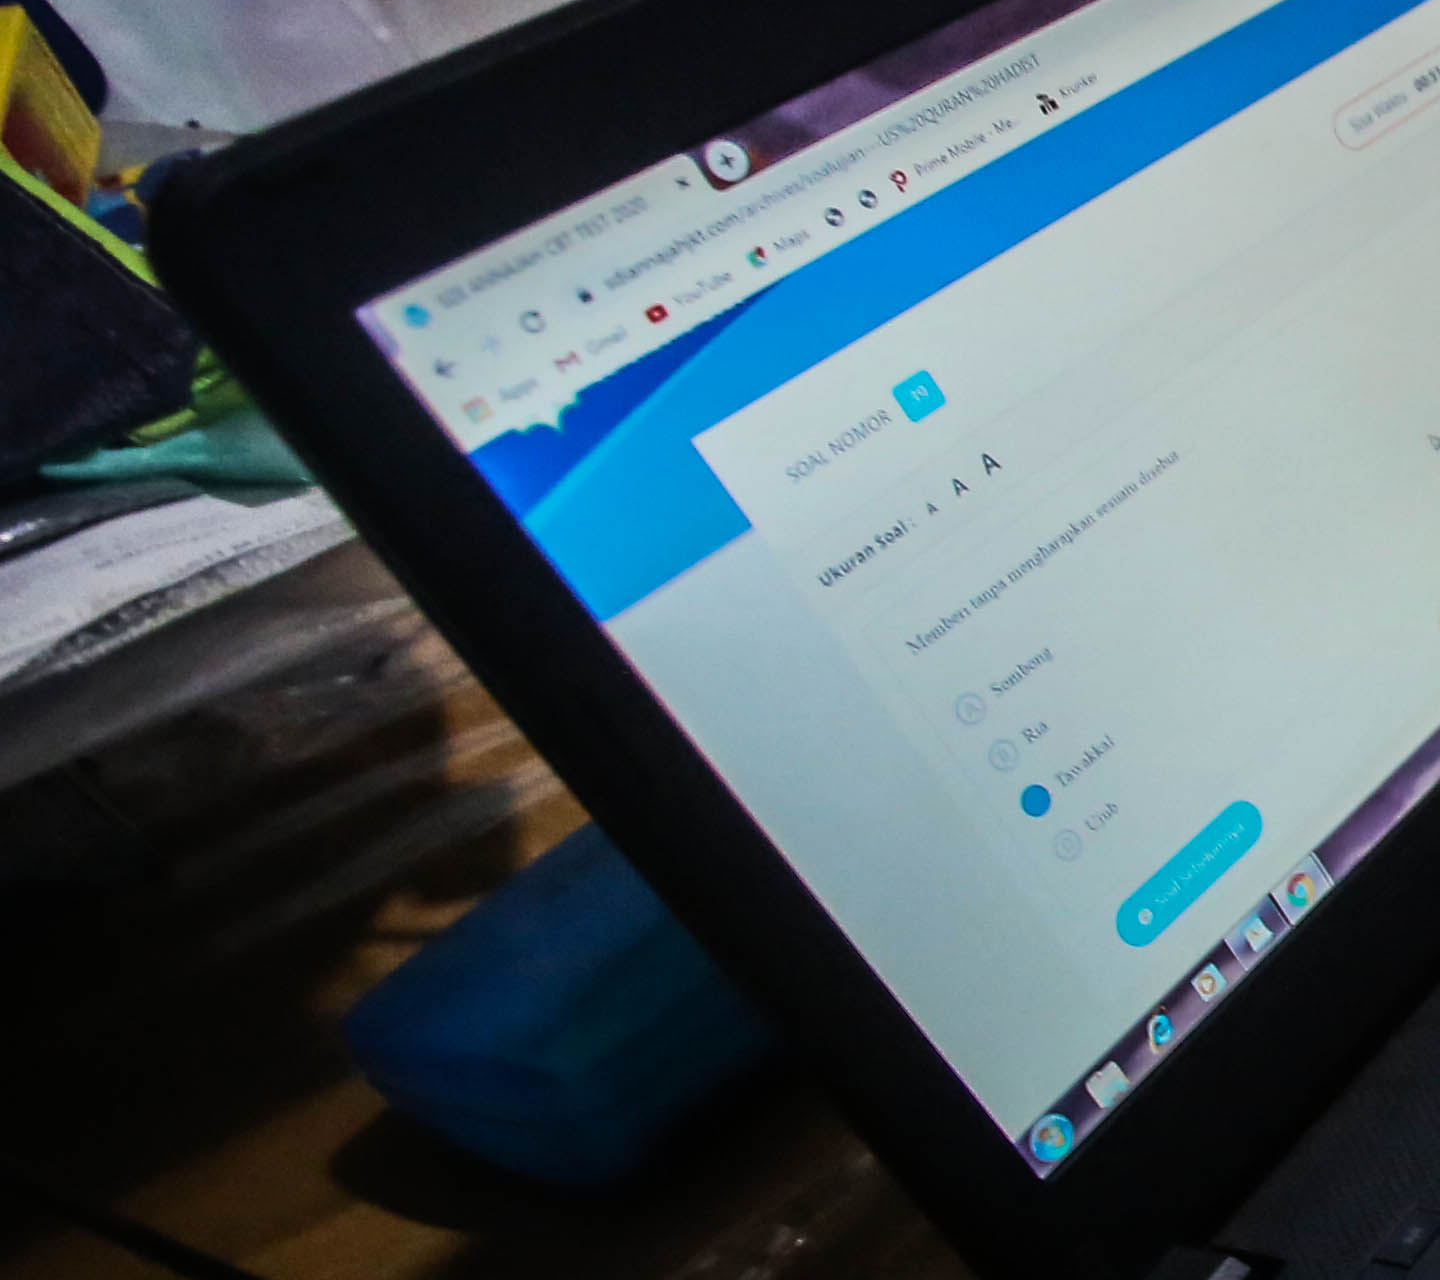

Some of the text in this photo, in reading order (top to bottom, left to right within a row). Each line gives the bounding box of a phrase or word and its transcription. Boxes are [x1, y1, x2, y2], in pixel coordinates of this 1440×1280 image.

[912, 151, 949, 178] Prime
[947, 130, 988, 160] Mobile
[784, 448, 832, 484] SOAL
[827, 408, 893, 456] NOMOR
[817, 542, 878, 588] Ukuran
[873, 519, 910, 550] Soal
[925, 501, 939, 516] A
[951, 477, 970, 497] A
[980, 452, 1003, 476] A
[968, 578, 1010, 610] tanpa
[1006, 513, 1097, 585] mengharapkan
